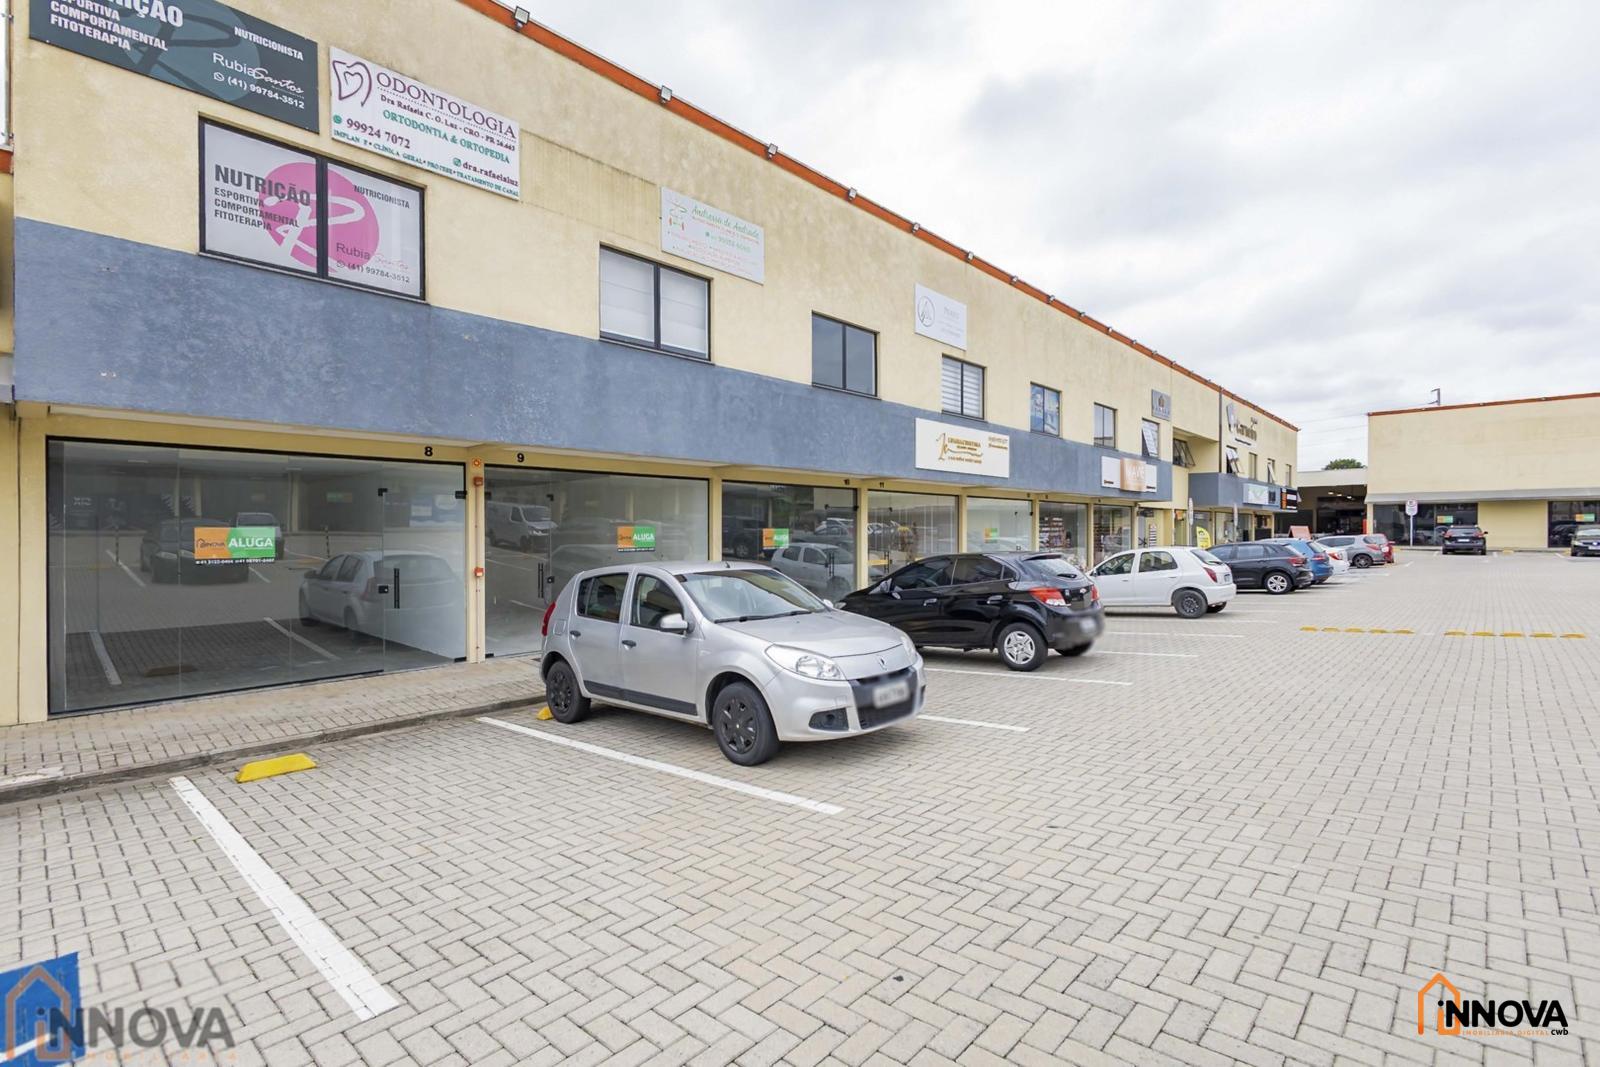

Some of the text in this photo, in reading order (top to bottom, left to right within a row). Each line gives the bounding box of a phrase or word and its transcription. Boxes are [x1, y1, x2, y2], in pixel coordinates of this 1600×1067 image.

[50, 0, 168, 51] COMPORTAMENTAL
[50, 14, 131, 50] FITOTERAPIA
[234, 26, 304, 61] NUTRICIONISTA
[212, 52, 256, 77] Rubia
[227, 76, 247, 91] (41)
[249, 84, 305, 109] 99784-3512
[376, 71, 517, 140] ODONTOLOGIA
[346, 118, 411, 149] 99924 7072
[383, 109, 510, 164] ORTODONTIA & ORTOPEDIA
[463, 126, 480, 138] CRO
[214, 164, 311, 207] NUTRIÇÃO
[214, 187, 265, 208] ESPORTIVA
[354, 185, 410, 209] NUTRICIONISTA
[214, 198, 300, 228] COMPORTAMENTAL
[214, 209, 272, 231] FITOTERAPIA
[336, 242, 371, 260] Rubia
[424, 446, 433, 457] 8
[516, 452, 525, 463] 9
[228, 537, 273, 548] ALUGA
[632, 533, 655, 541] ALUGA
